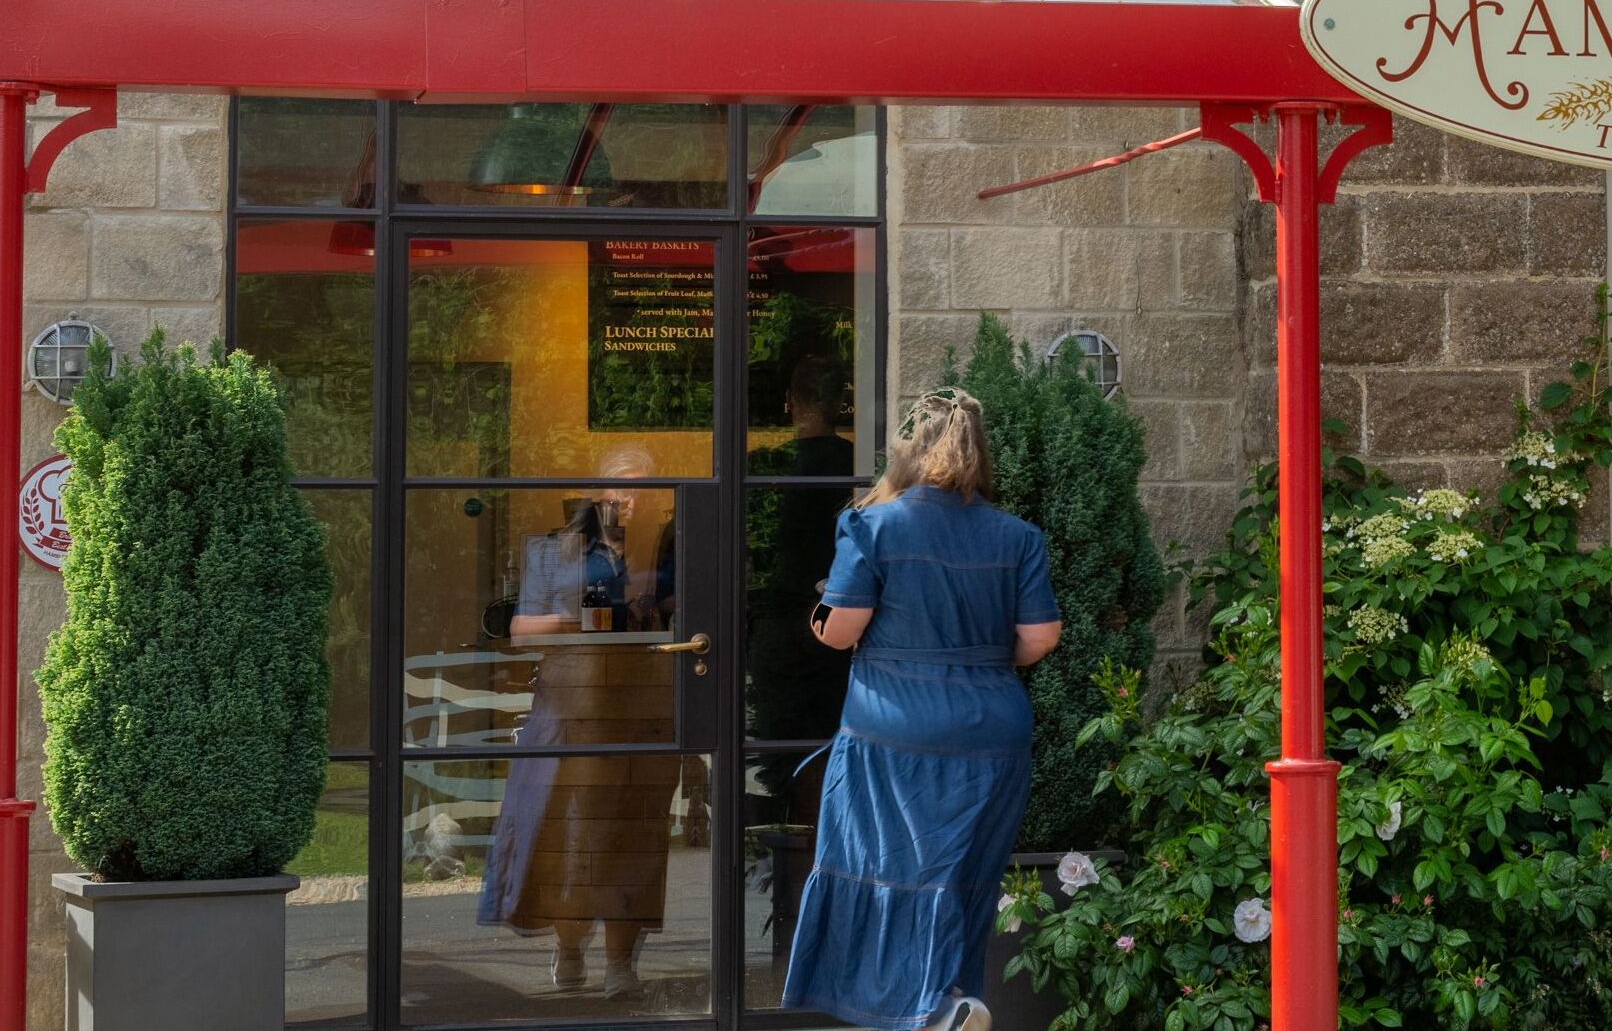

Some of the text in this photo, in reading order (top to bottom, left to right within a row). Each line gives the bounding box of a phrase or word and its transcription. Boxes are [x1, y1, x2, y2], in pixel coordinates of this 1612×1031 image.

[606, 240, 700, 250] BAKERY BASKETS
[656, 271, 664, 279] of
[665, 308, 682, 316] with
[752, 309, 776, 319] Honey
[605, 325, 657, 338] LUNCH
[604, 340, 676, 351] SANDWICHES
